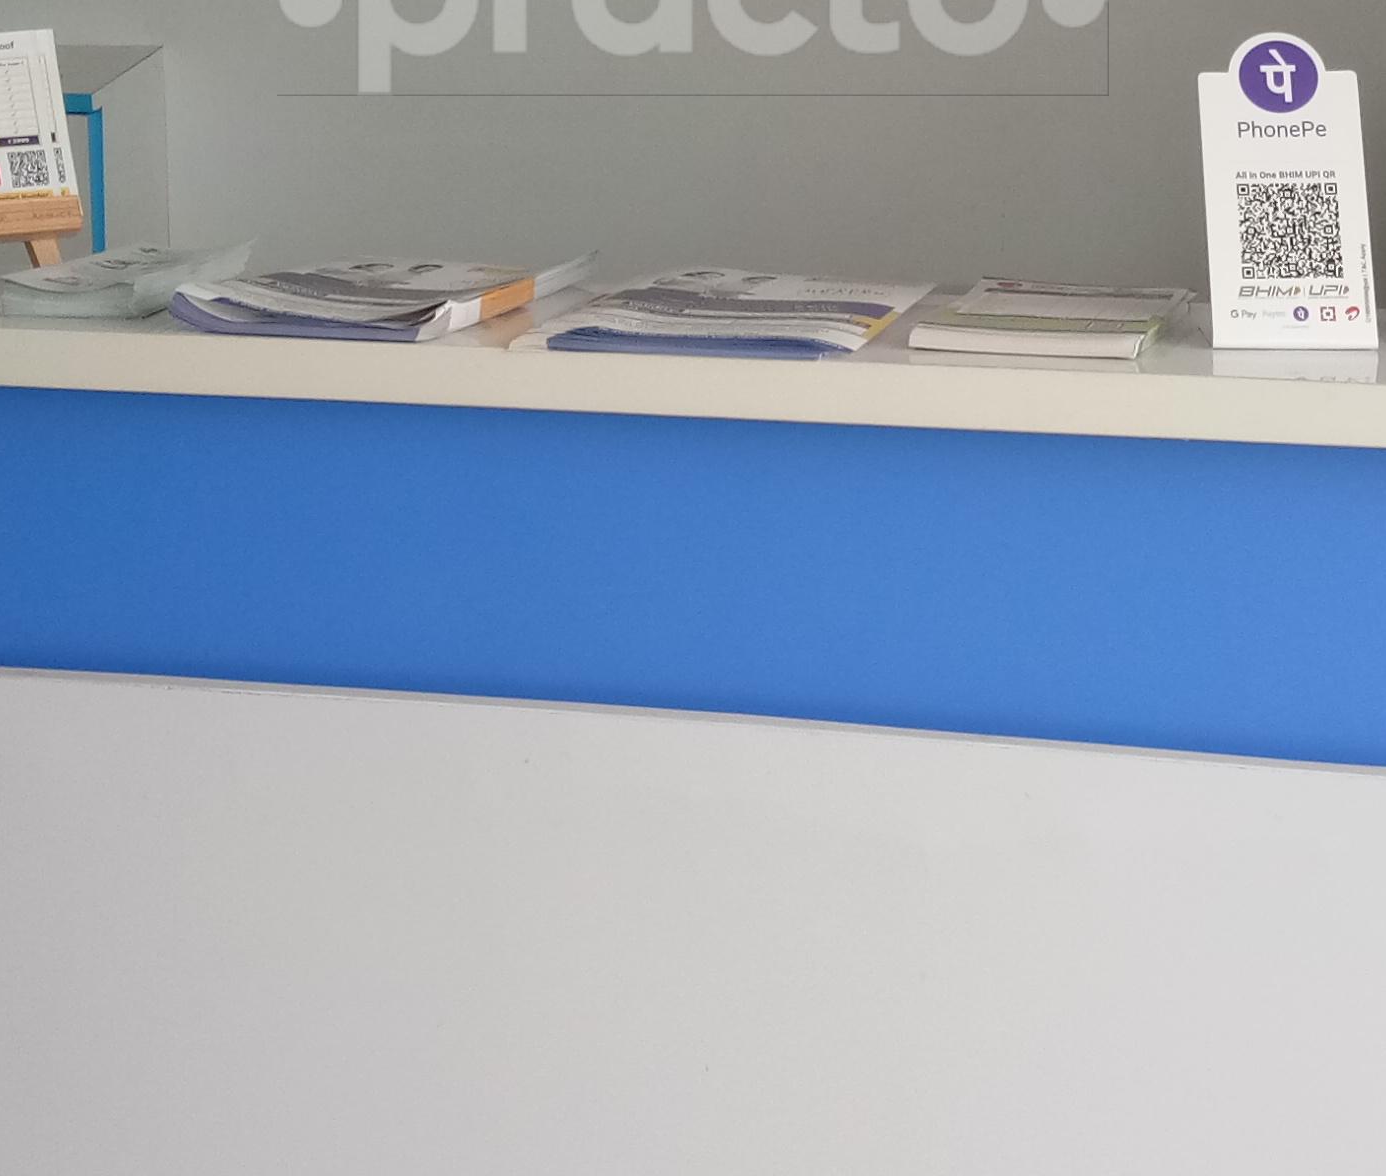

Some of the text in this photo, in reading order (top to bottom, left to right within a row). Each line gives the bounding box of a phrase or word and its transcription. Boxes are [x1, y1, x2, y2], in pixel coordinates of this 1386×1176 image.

[1237, 121, 1327, 138] PhonePe
[1235, 171, 1247, 179] All
[1259, 170, 1277, 179] One
[1278, 170, 1303, 179] BHIM
[1305, 170, 1321, 179] UPI
[1322, 170, 1336, 179] QR
[1239, 284, 1344, 298] BHIM UPI
[1241, 310, 1257, 320] Pay
